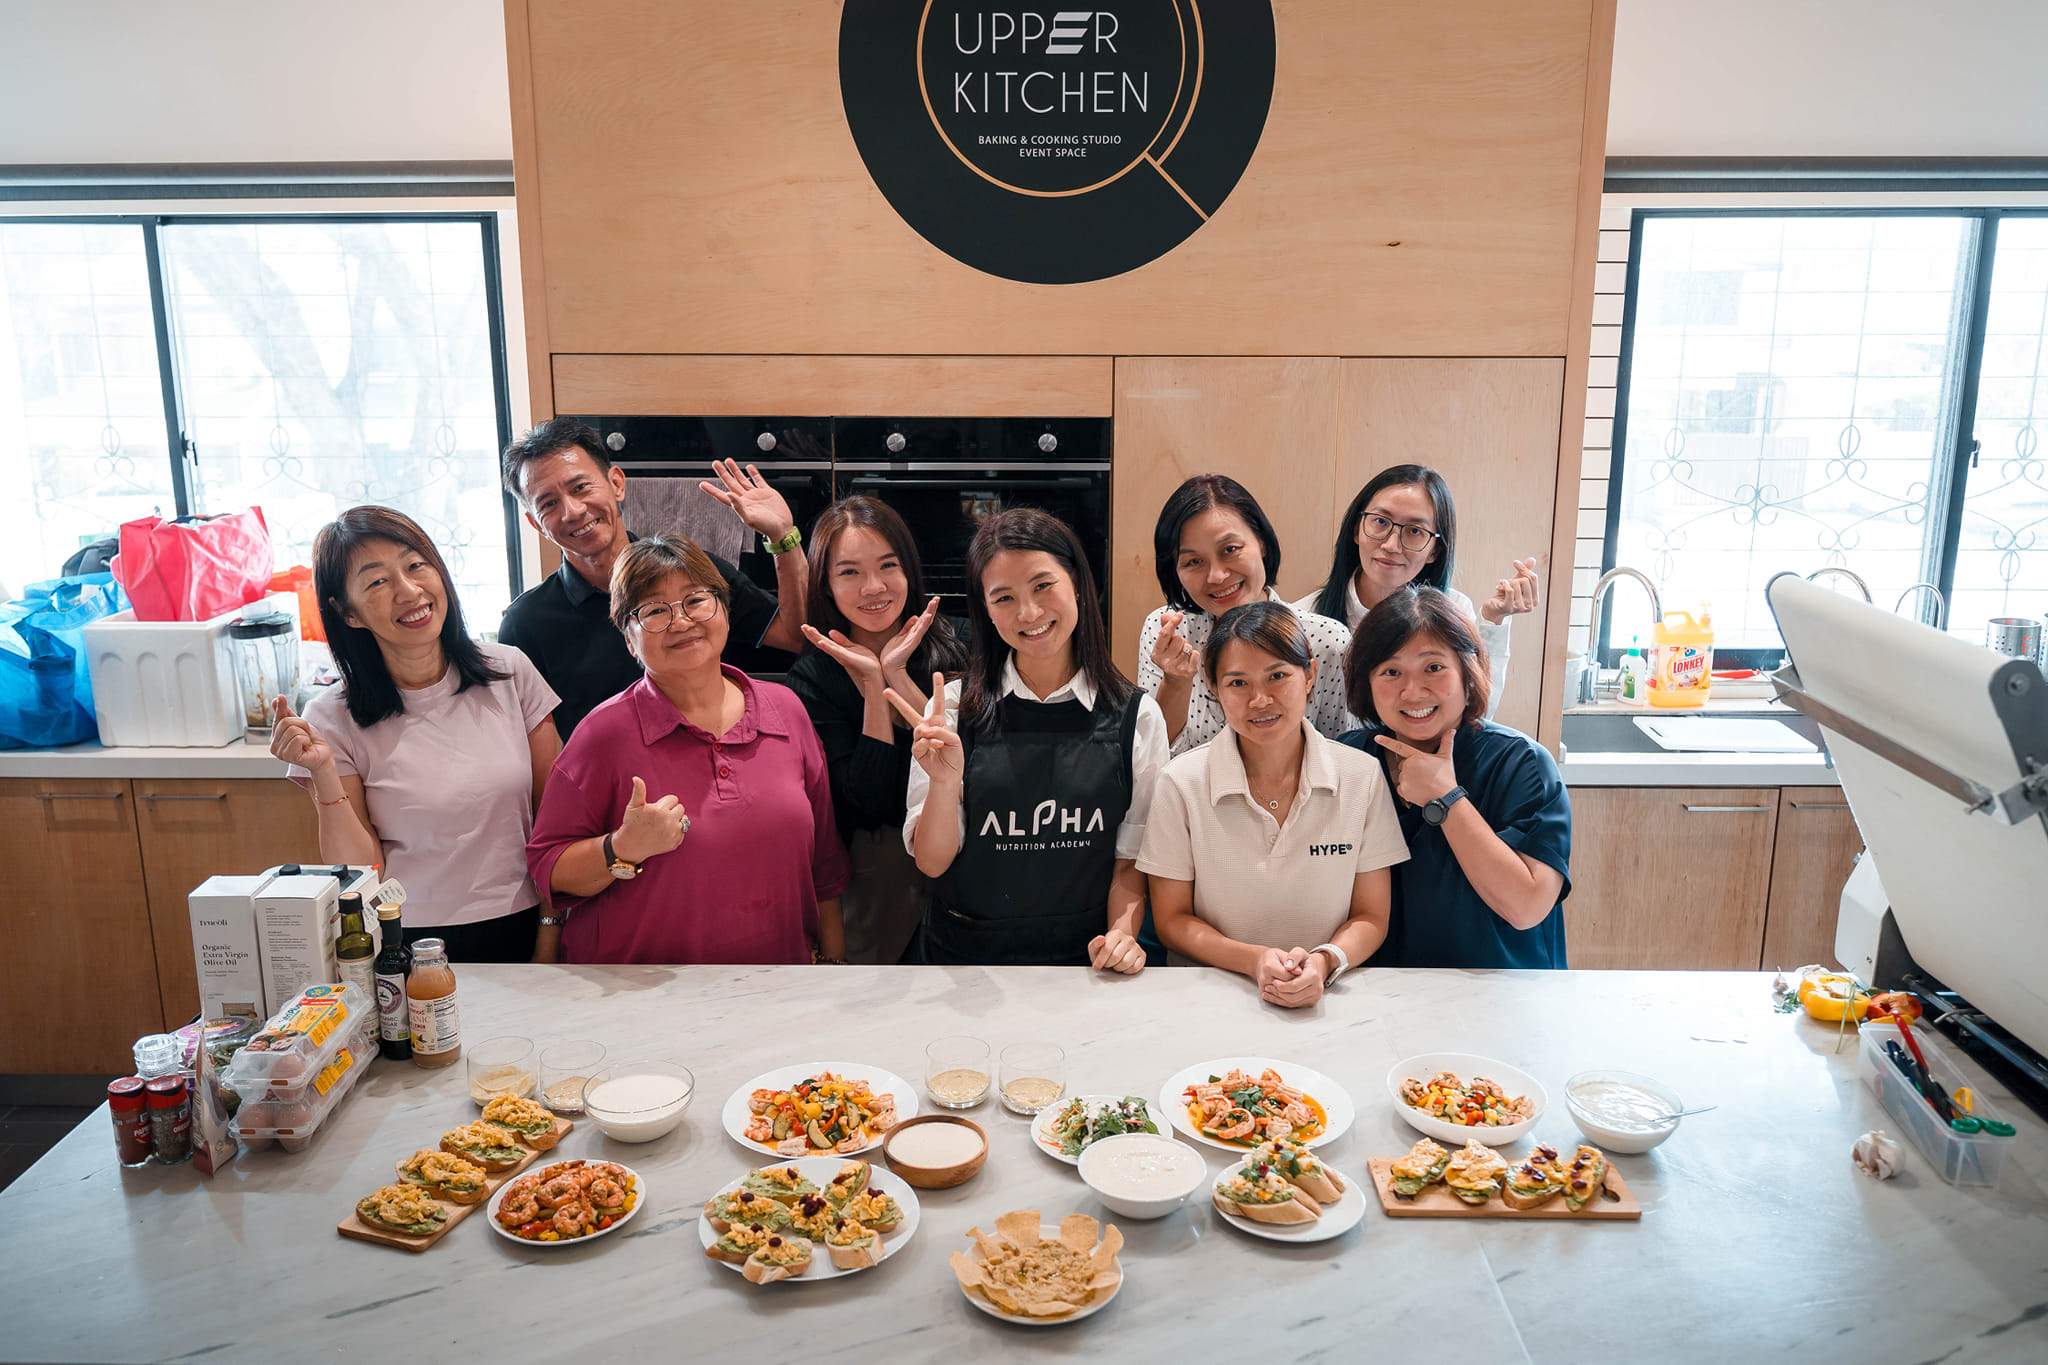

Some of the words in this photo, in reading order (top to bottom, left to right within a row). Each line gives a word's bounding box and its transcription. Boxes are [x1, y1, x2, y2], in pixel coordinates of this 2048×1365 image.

[955, 11, 1119, 55] UPPER
[955, 71, 1148, 114] KITCHEN
[978, 135, 1017, 145] BAKING
[1020, 135, 1028, 145] &
[1031, 135, 1078, 145] COOKING
[1082, 135, 1122, 145] STUDIO
[1019, 148, 1052, 157] EVENT
[1055, 148, 1087, 157] SPACE
[1672, 656, 1705, 674] LONKEY
[979, 799, 1104, 836] ALPHA
[995, 842, 1046, 851] NUTRITION
[1050, 840, 1091, 849] ACADEMY
[225, 951, 248, 959] Virgin
